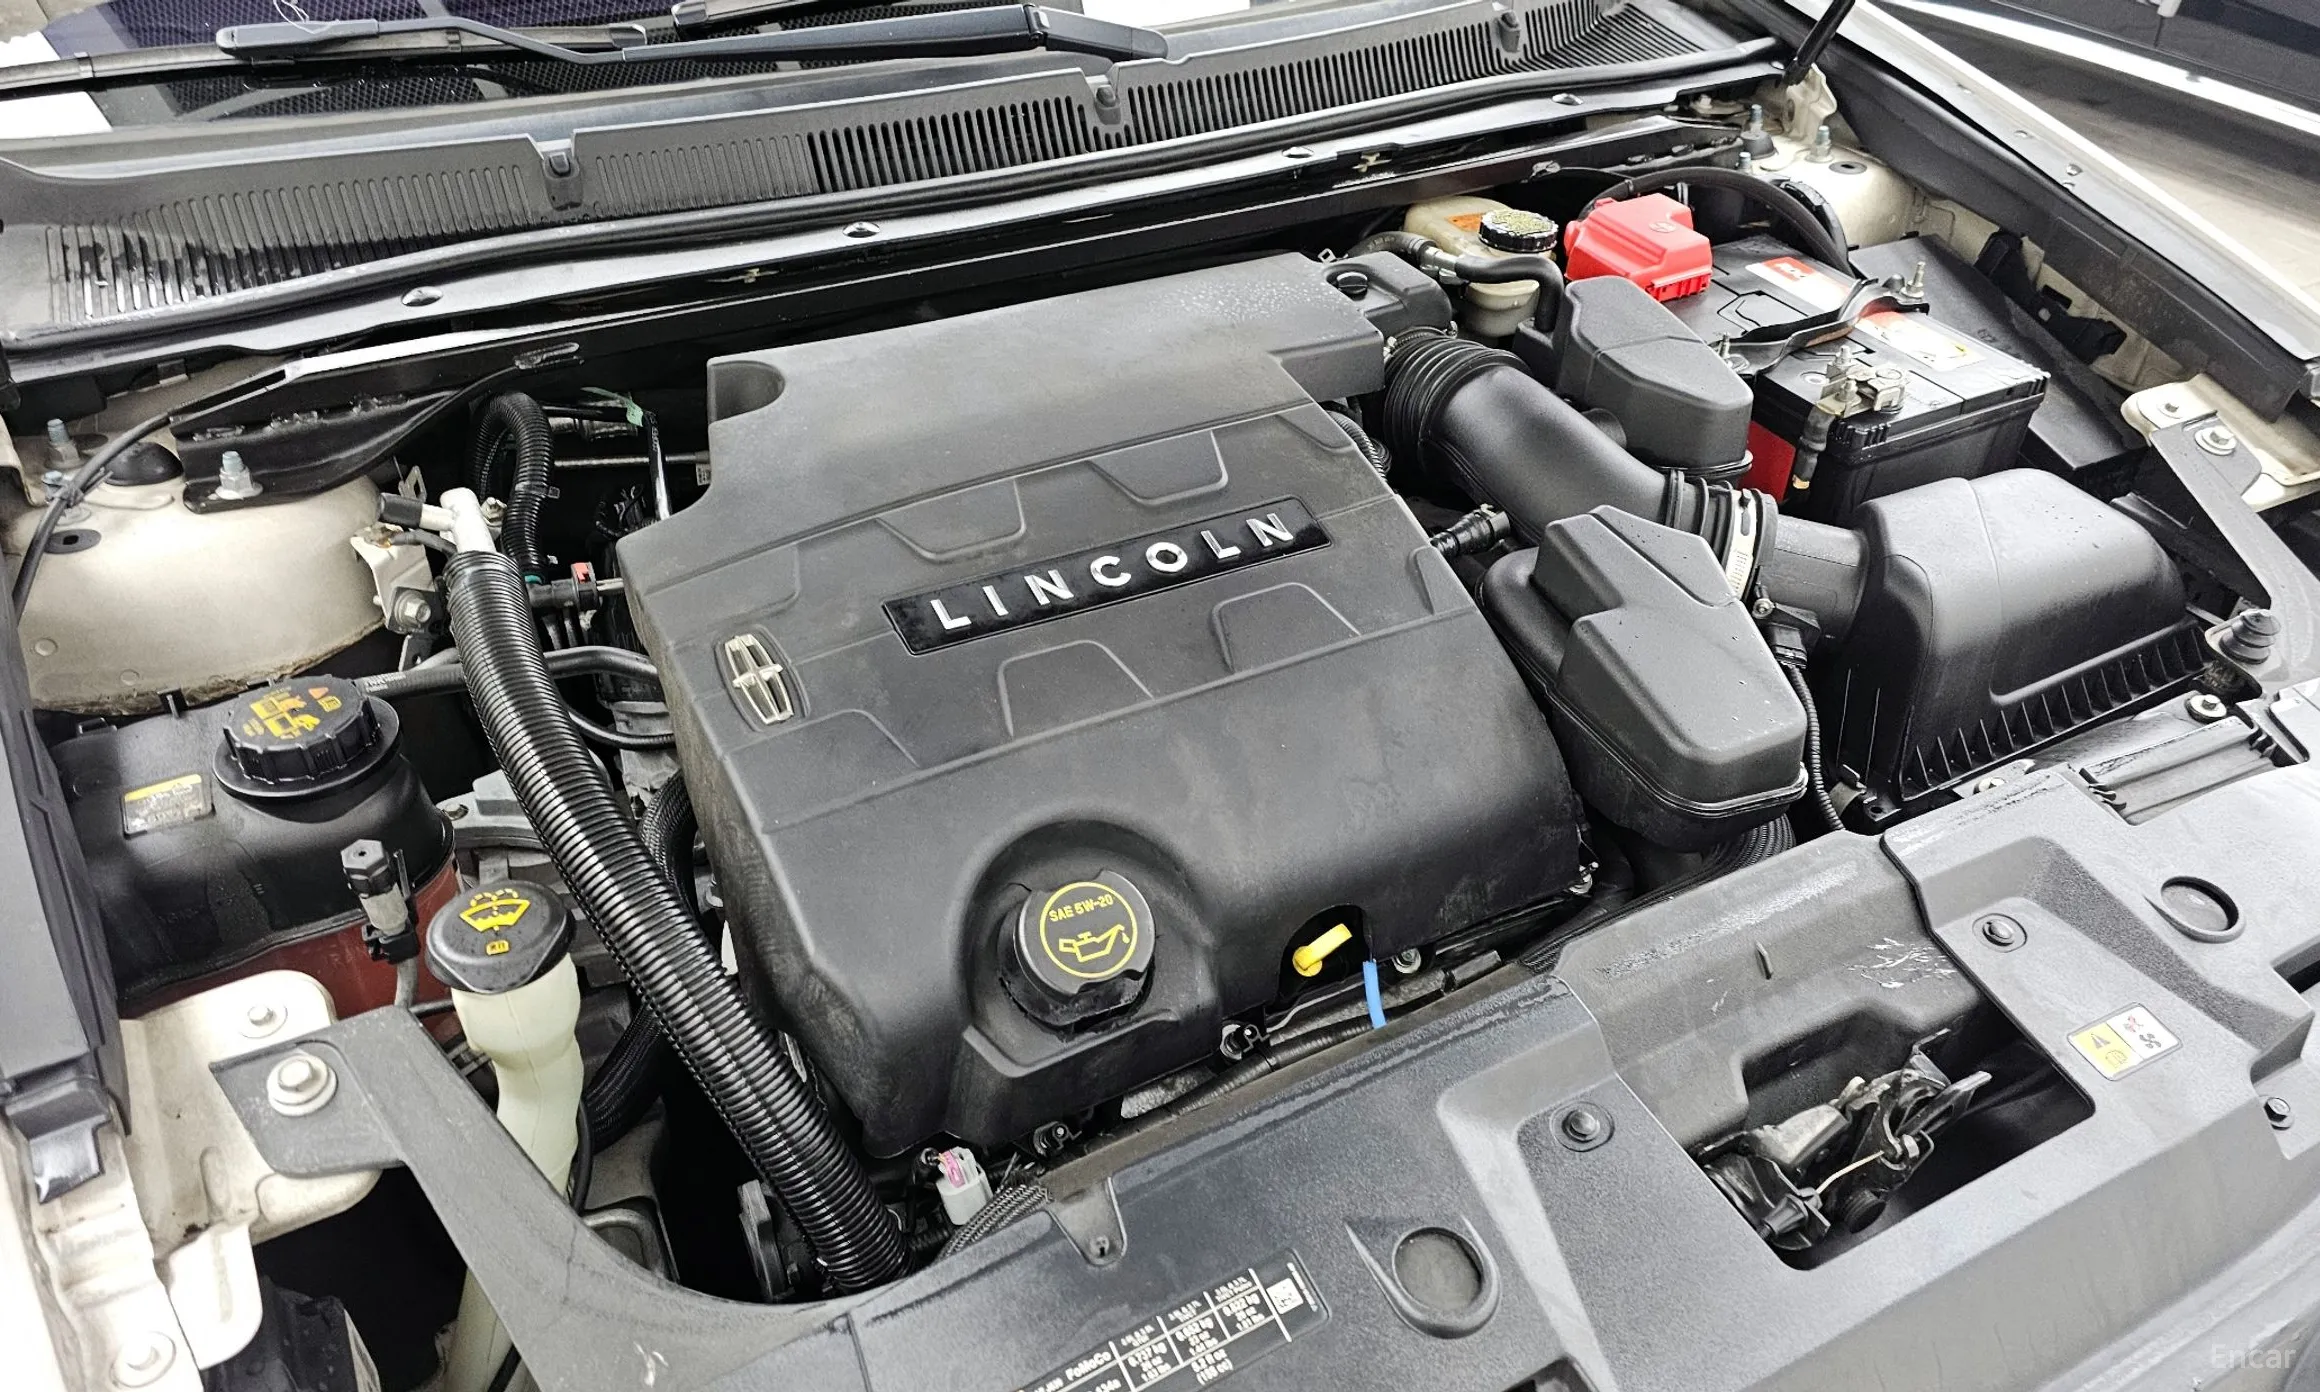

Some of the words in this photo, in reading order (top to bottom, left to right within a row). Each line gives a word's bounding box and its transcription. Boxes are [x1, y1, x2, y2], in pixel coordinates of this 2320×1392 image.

[929, 513, 1294, 630] LINCOLN
[1049, 905, 1075, 922] SAE
[1074, 893, 1114, 914] 5W-20
[1065, 1352, 1111, 1381] FoMoCo
